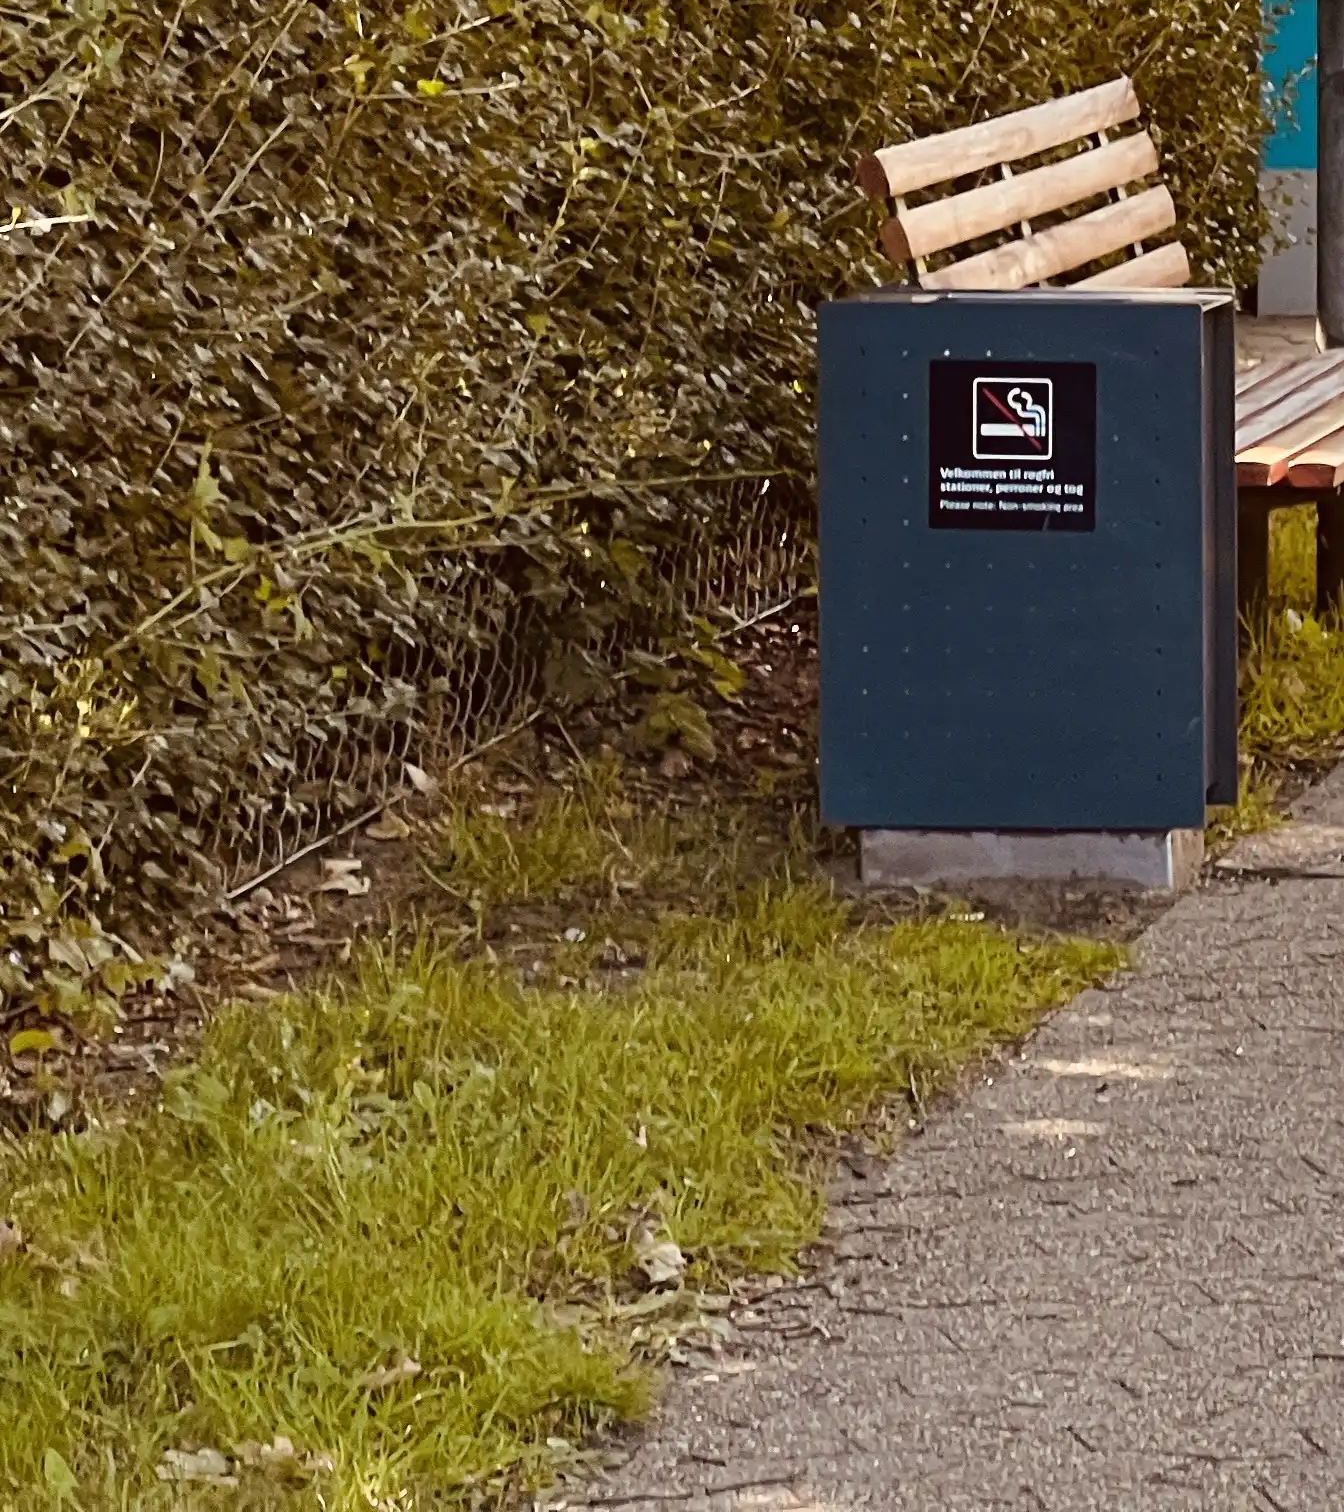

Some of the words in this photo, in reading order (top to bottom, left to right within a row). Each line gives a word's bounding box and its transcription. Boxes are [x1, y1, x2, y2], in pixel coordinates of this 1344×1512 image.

[940, 467, 1007, 480] Velkommen
[1009, 468, 1021, 480] til
[1046, 484, 1062, 496] og
[1064, 483, 1084, 496] tog
